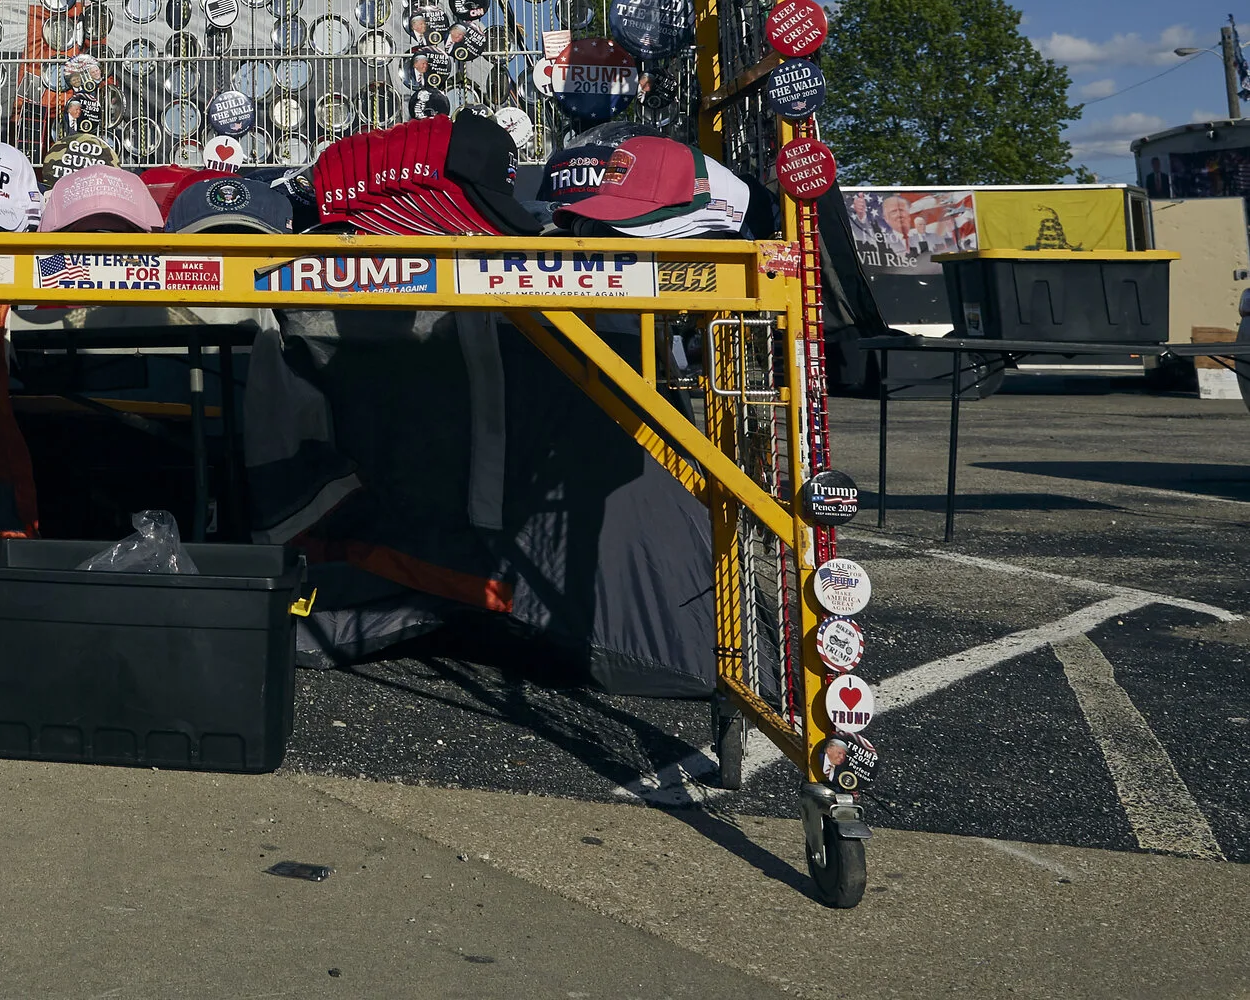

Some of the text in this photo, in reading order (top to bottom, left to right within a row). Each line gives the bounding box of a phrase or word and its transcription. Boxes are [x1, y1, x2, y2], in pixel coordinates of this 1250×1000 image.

[422, 10, 445, 18] TRUMP
[616, 3, 646, 20] THE
[771, 2, 797, 24] KEEP
[623, 18, 655, 31] TRUMP
[771, 5, 814, 40] AMERICA
[466, 27, 487, 42] TRUMP
[783, 18, 815, 45] GREAT
[791, 28, 822, 54] AGAIN
[426, 52, 449, 60] TRUMP
[558, 66, 632, 82] TRUMP
[773, 67, 811, 87] BUILD
[574, 81, 608, 94] 2016
[769, 77, 823, 100] THE WALL
[80, 99, 101, 108] TRUMP
[215, 97, 245, 112] BUILD
[777, 89, 818, 105] TRUMP 2020
[211, 104, 254, 121] THE WALL
[219, 113, 251, 126] TRUMP 2020
[69, 140, 103, 156] GOD
[785, 142, 812, 159] KEEP
[206, 159, 239, 174] TRUMP
[568, 157, 599, 167] 2020
[780, 151, 827, 174] AMERICA
[550, 166, 606, 190] TRUM
[789, 165, 823, 183] GREAT
[794, 177, 828, 195] AGAIN
[68, 253, 161, 268] VETERANS
[182, 262, 204, 270] MAKE
[477, 251, 638, 273] TRUMP
[884, 252, 918, 268] Rise
[125, 267, 161, 281] FOR
[166, 271, 220, 282] AMERICA
[488, 274, 623, 289] PENCE
[166, 283, 191, 291] GREAT
[810, 482, 858, 500] Trump
[812, 502, 857, 513] Pence 2020
[826, 562, 857, 570] BIKERS
[826, 595, 861, 603] AMERICA
[835, 622, 855, 638] BIKERS
[825, 644, 852, 662] TRUMP
[831, 710, 870, 725] TRUMP
[847, 741, 878, 762] TRUMP
[853, 752, 875, 768] 20/20
[848, 762, 871, 777] Perfect
[854, 770, 874, 783] Vision"
